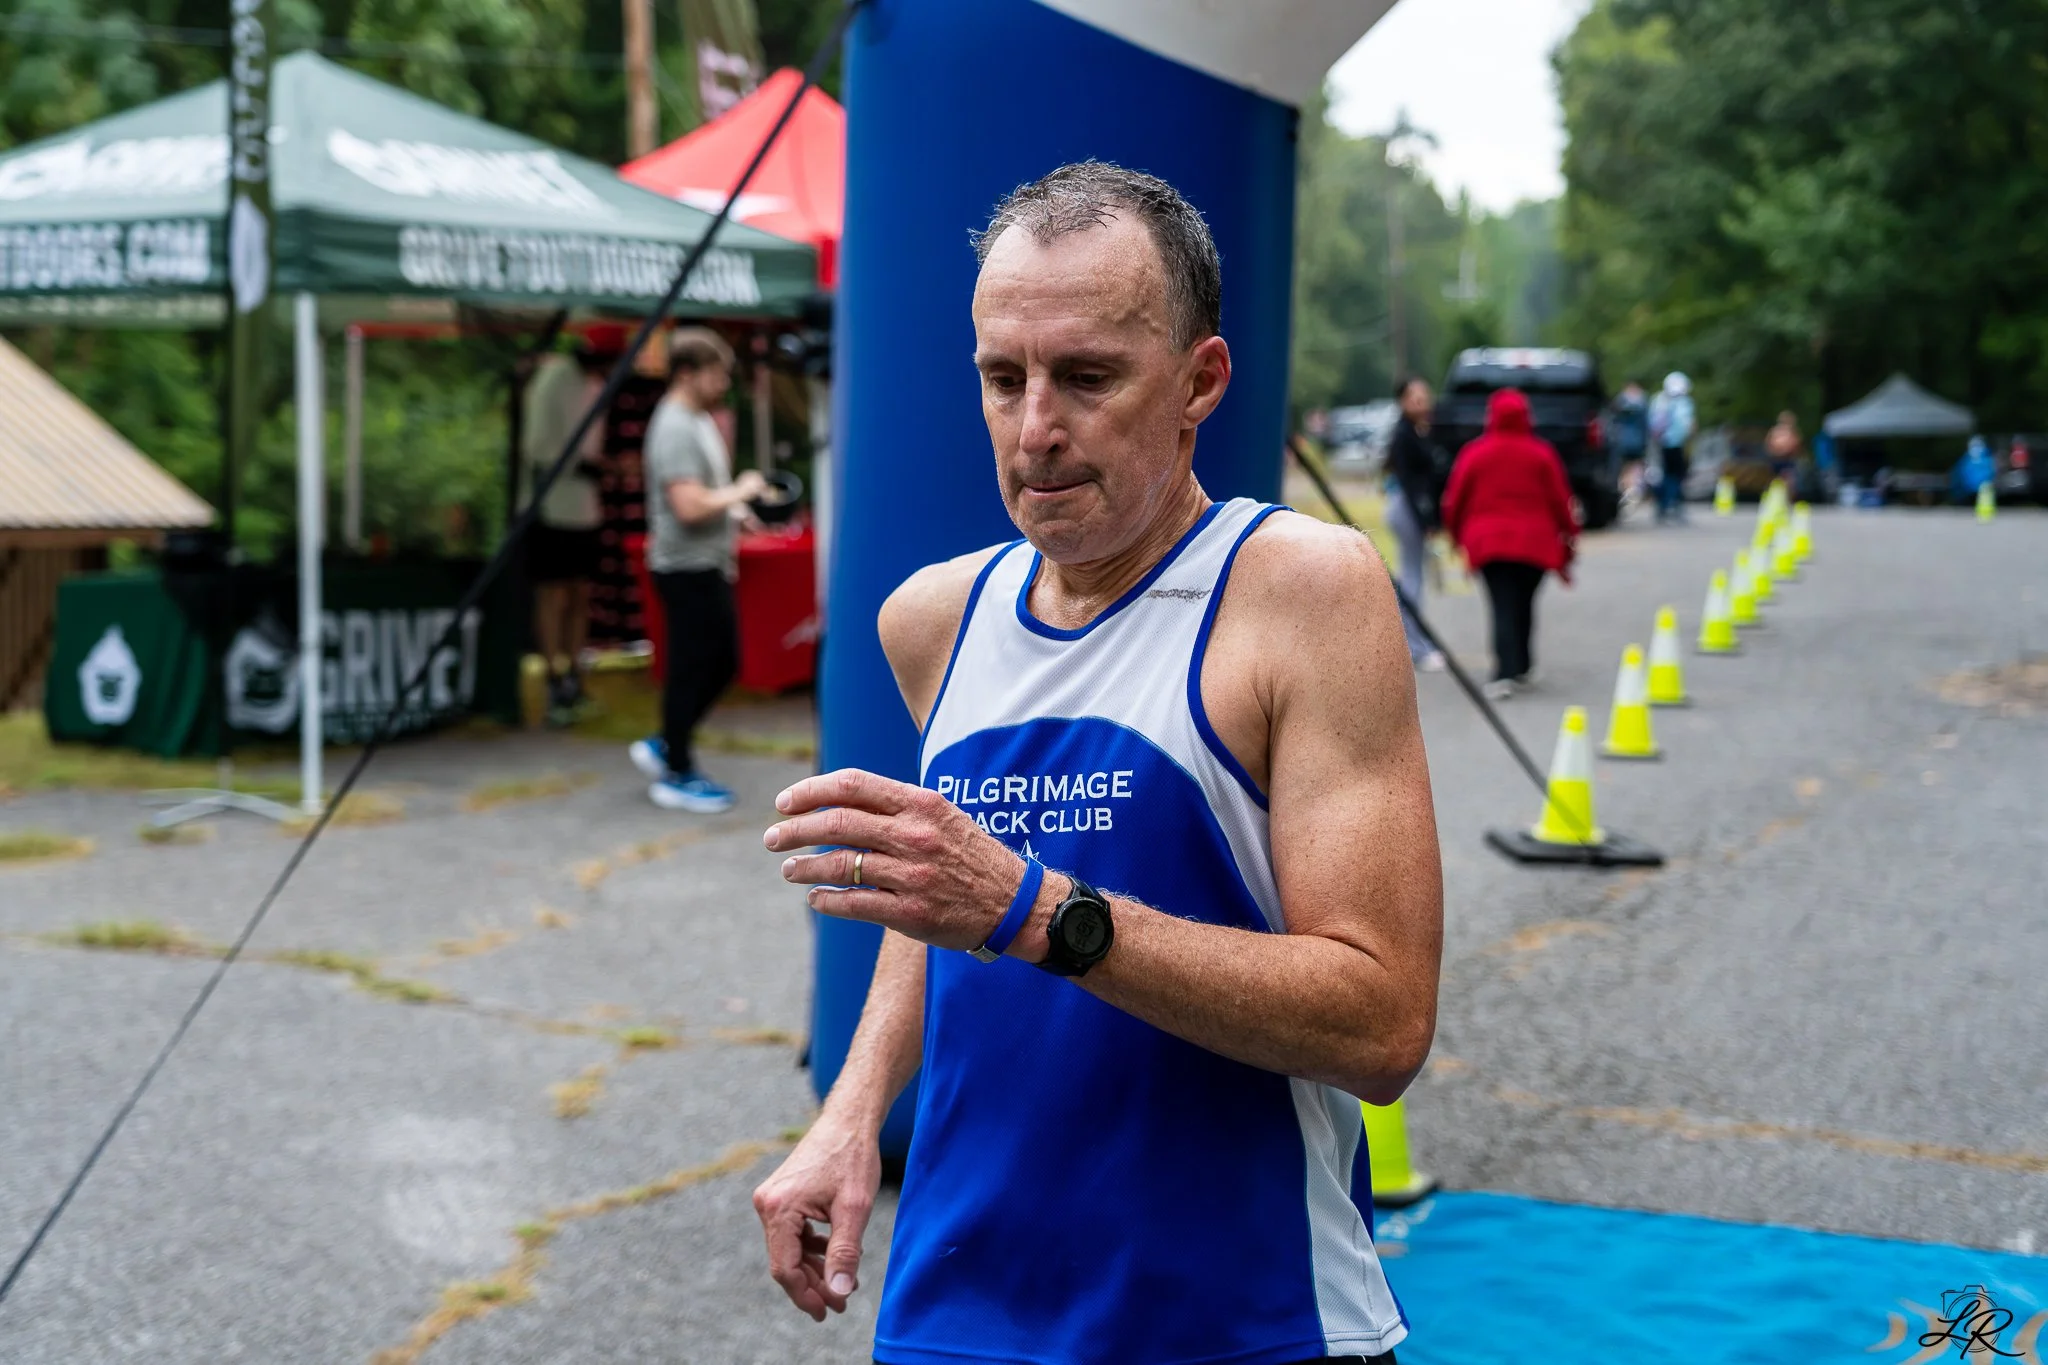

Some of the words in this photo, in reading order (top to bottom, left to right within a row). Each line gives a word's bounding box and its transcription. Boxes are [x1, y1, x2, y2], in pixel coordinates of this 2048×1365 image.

[938, 770, 1133, 805] PILGRIMAGE
[964, 810, 1031, 834] ACK
[1039, 807, 1113, 833] CLUB
